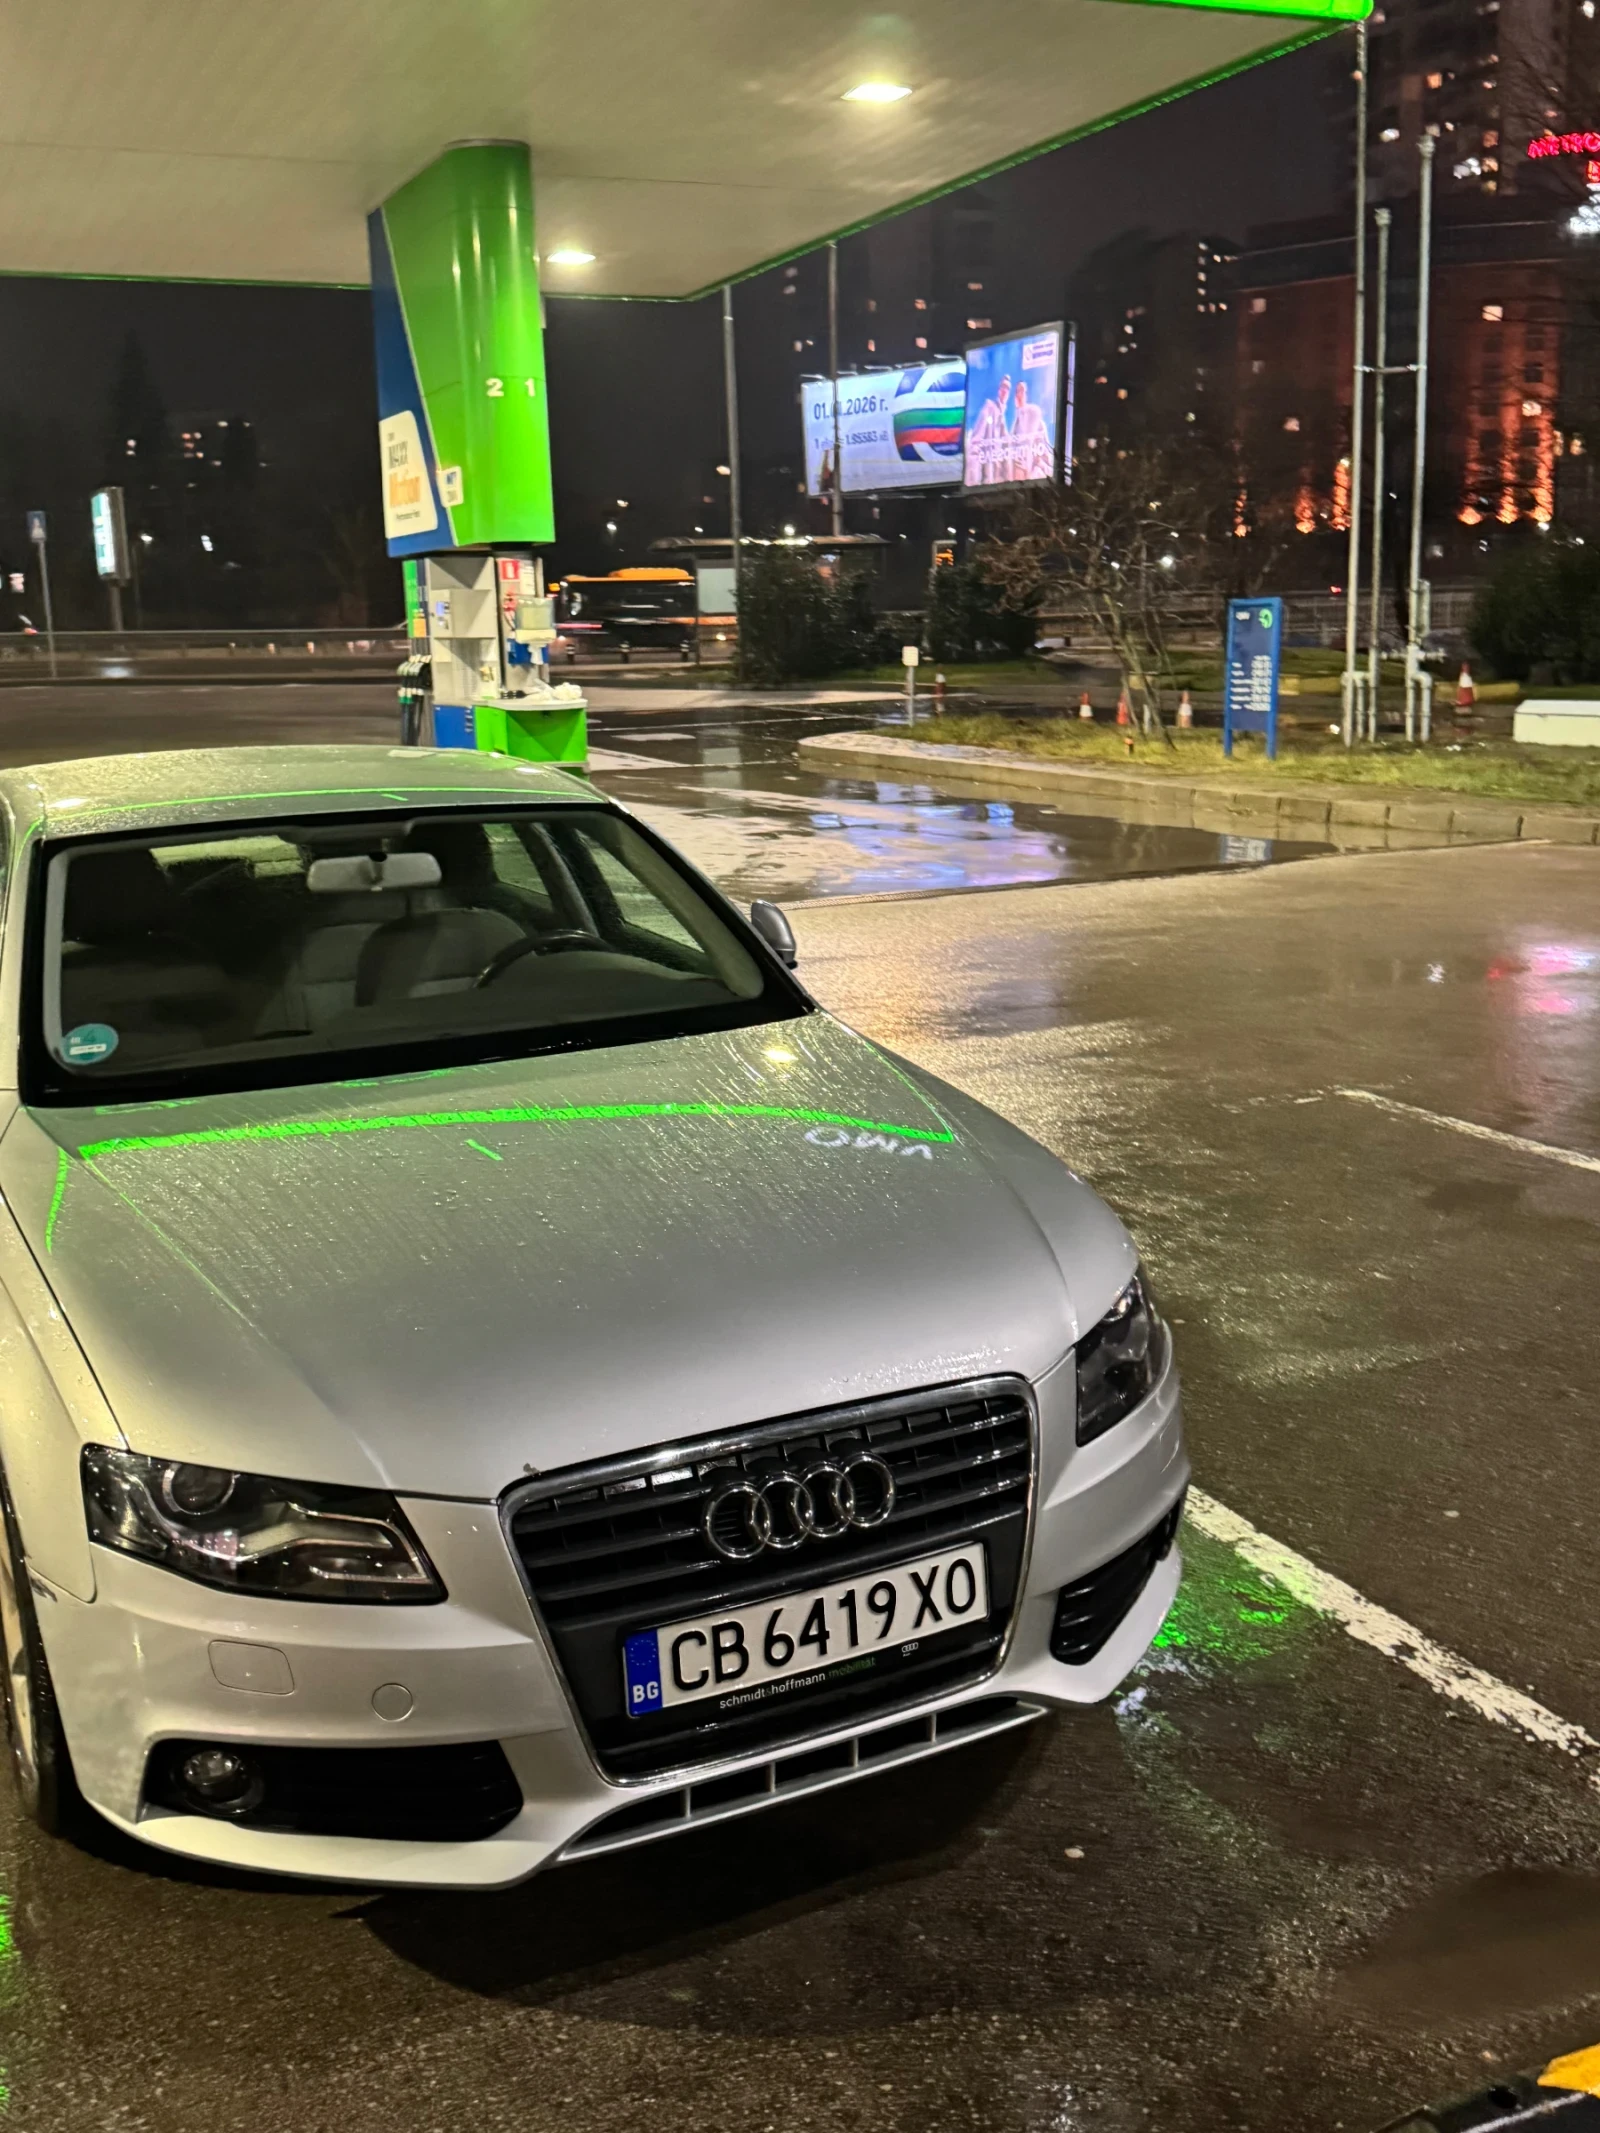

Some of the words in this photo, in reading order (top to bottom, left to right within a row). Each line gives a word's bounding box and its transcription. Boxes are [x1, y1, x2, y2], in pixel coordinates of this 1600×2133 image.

[486, 377, 505, 397] 2
[524, 377, 536, 397] 1
[671, 1619, 750, 1691] CB
[763, 1580, 898, 1668] 6419
[910, 1557, 977, 1630] XO
[632, 1680, 660, 1704] BG
